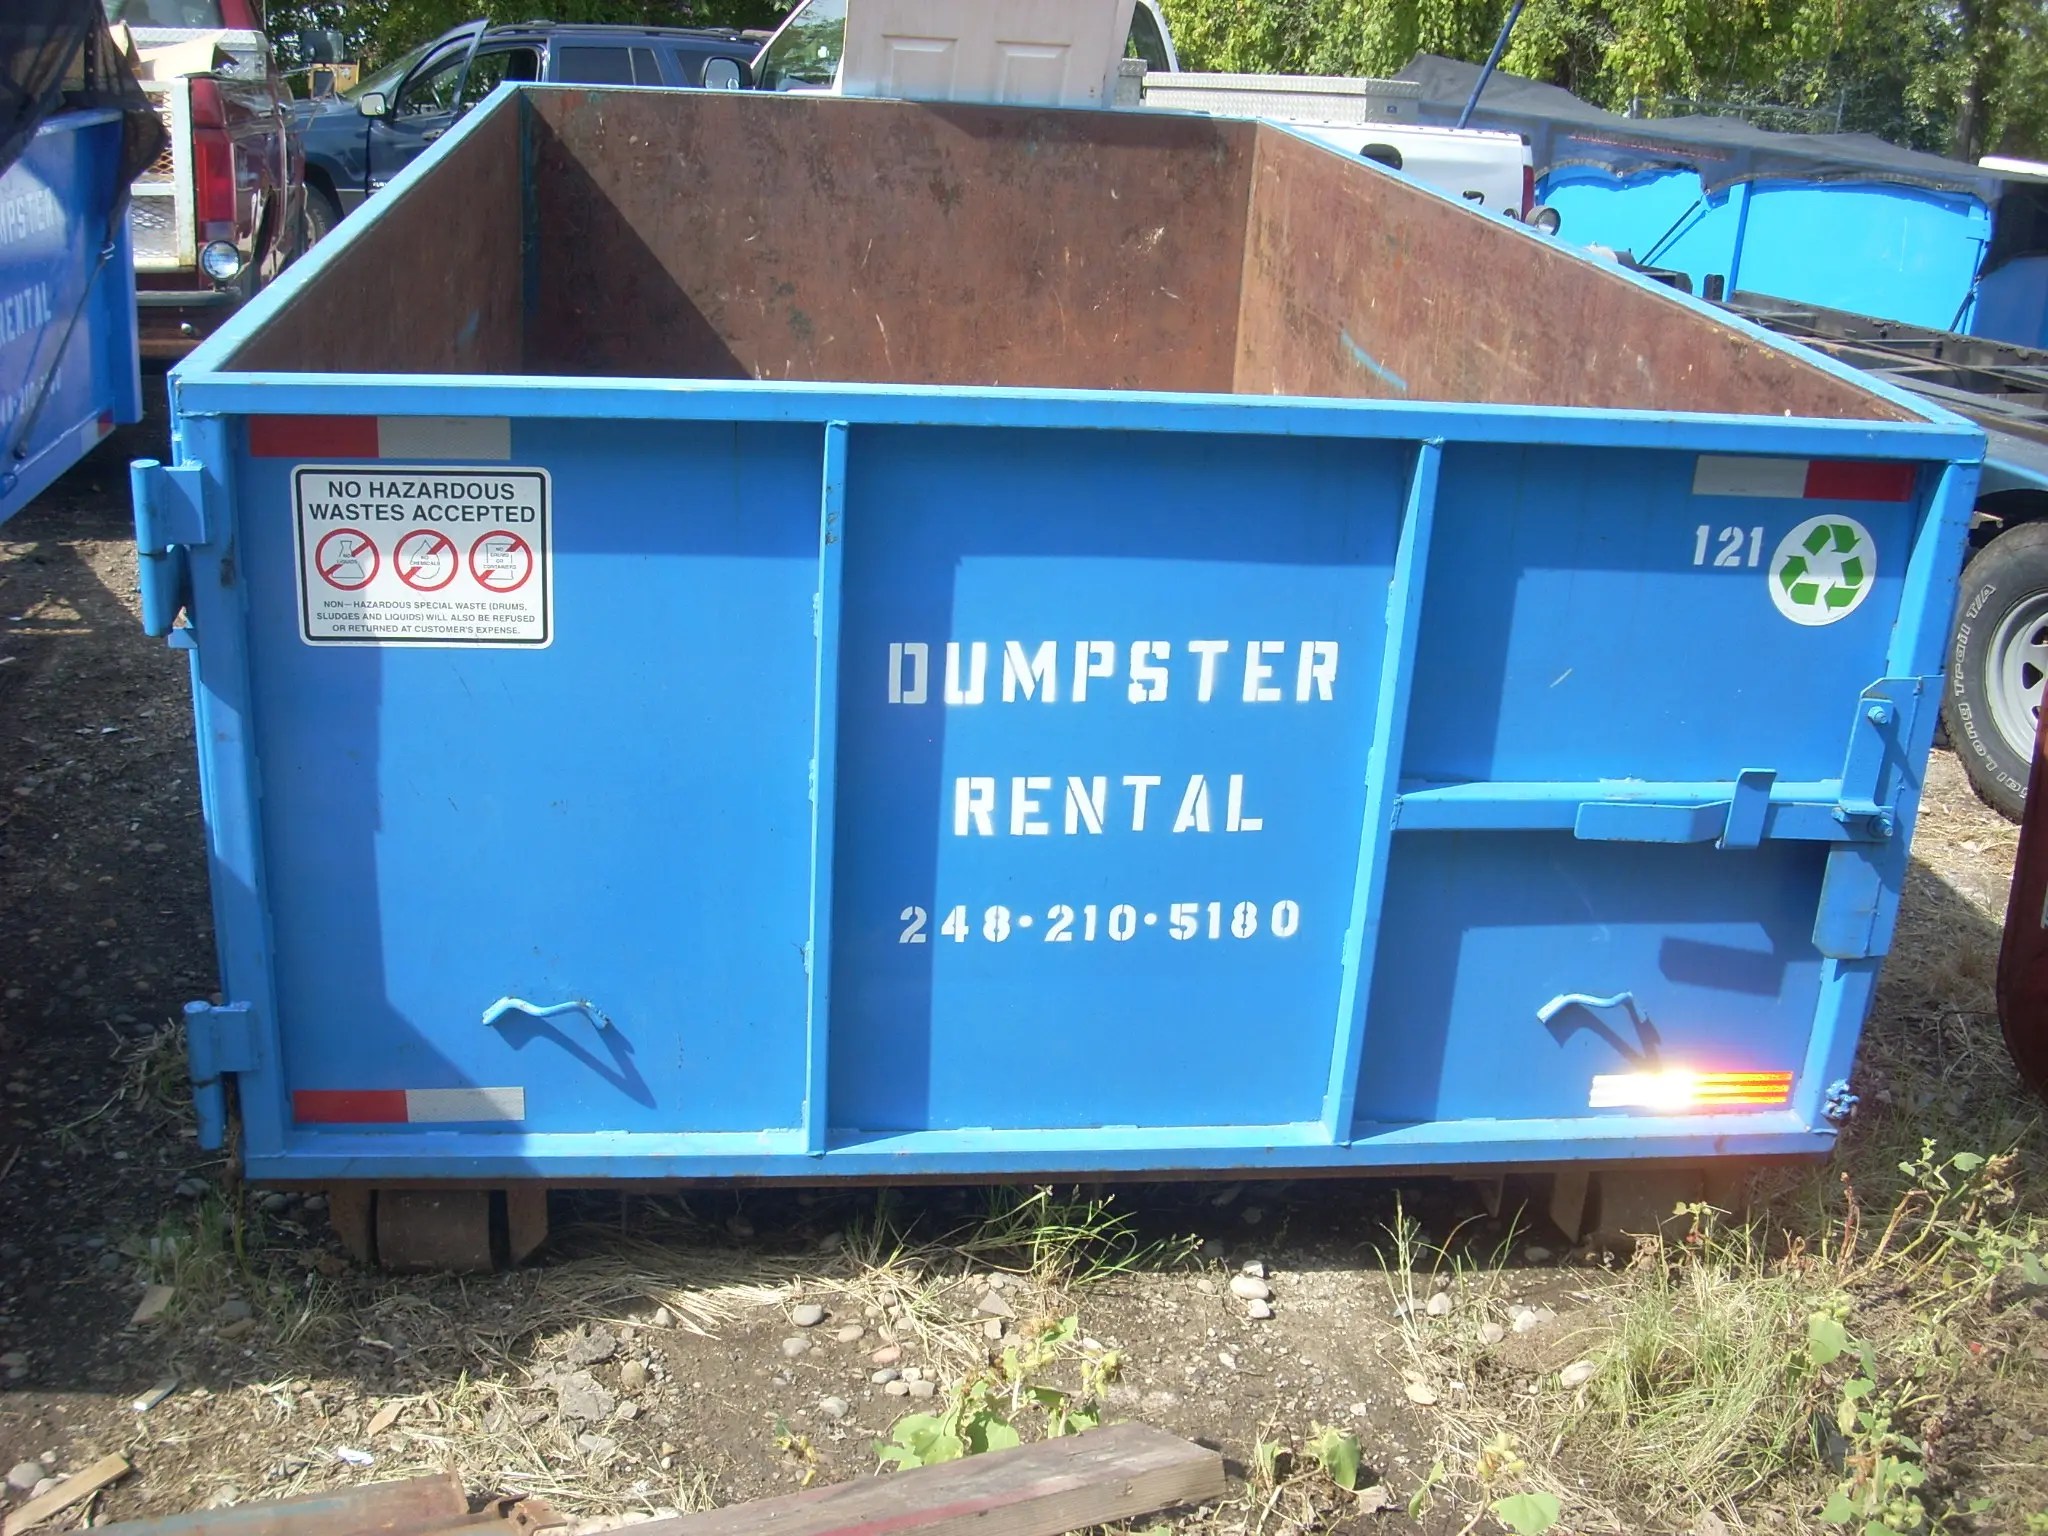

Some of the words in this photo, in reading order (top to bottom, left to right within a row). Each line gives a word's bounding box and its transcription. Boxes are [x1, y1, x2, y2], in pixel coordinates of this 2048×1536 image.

[329, 481, 361, 498] NO
[369, 481, 515, 500] HAZARDOUS
[309, 503, 405, 521] WASTES
[412, 504, 536, 523] ACCEPTED
[1693, 525, 1764, 567] 121
[414, 601, 453, 609] SPECIAL
[455, 602, 487, 610] WASTE
[316, 612, 360, 620] SLUDGES
[384, 613, 424, 621] LIQUIDS)
[450, 614, 475, 622] ALSO
[478, 614, 490, 622] BE
[493, 615, 536, 623] REFUSED
[332, 624, 346, 632] OR
[414, 625, 474, 633] CUSTOMER'S
[888, 640, 1339, 704] DUMPSTER
[954, 774, 1264, 836] RENTAL
